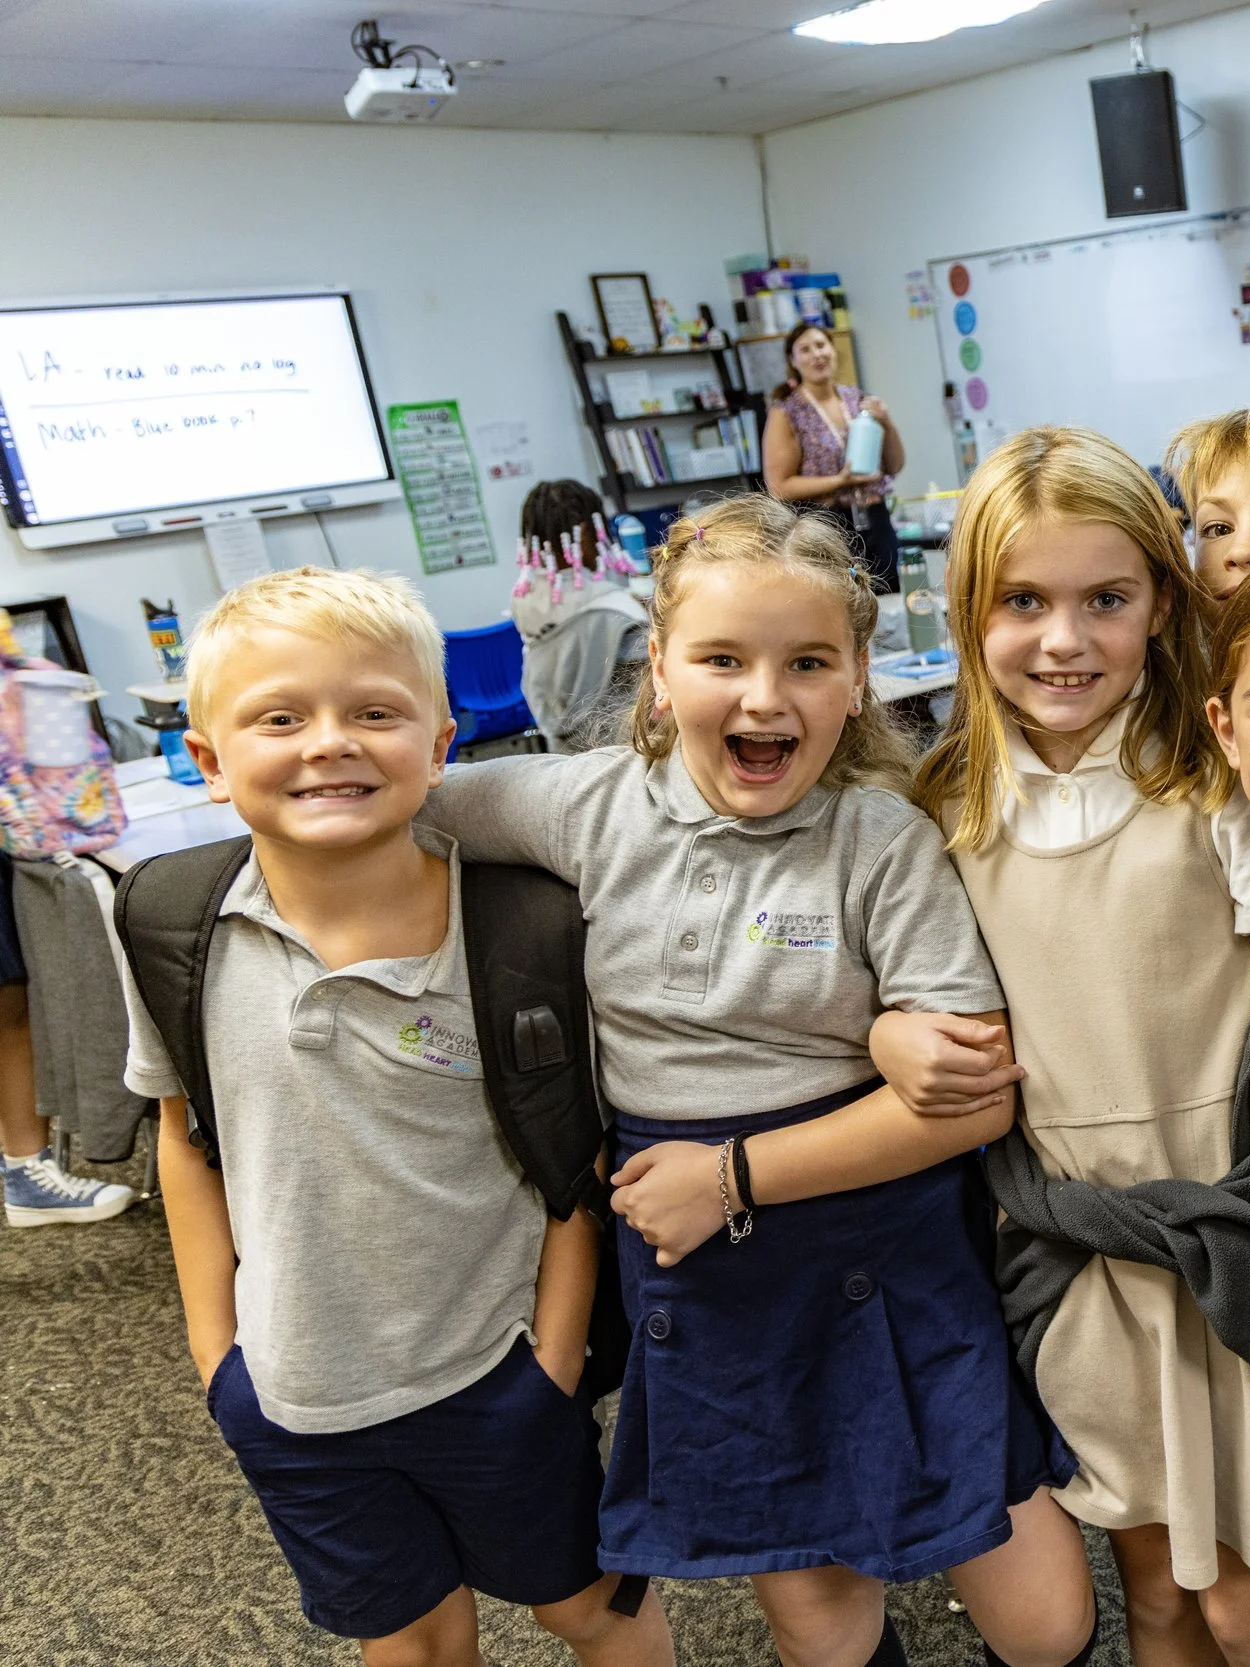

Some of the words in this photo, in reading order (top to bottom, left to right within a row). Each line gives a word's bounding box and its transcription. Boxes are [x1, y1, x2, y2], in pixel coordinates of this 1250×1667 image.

[17, 350, 62, 383] LA
[103, 364, 147, 380] read
[190, 364, 226, 376] min
[272, 356, 298, 377] log
[37, 418, 107, 452] Math
[131, 417, 174, 438] Blue
[788, 938, 814, 947] heart
[424, 1053, 452, 1067] HEART
